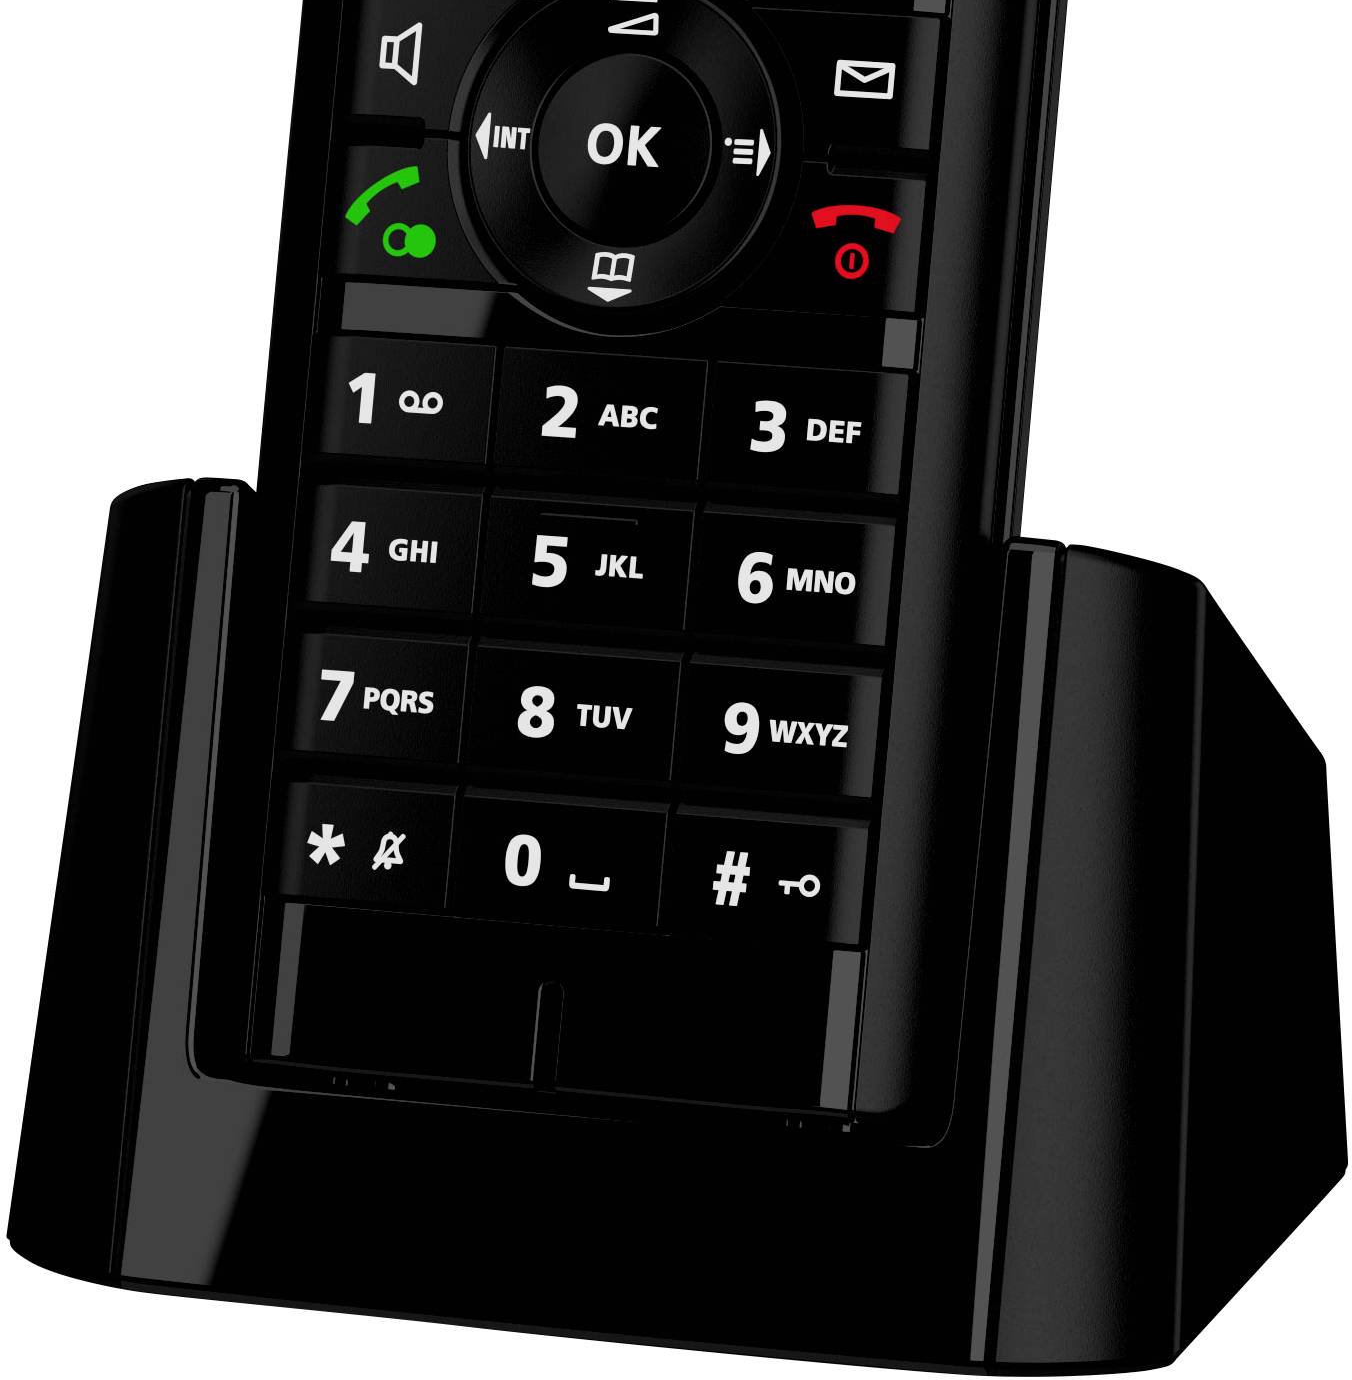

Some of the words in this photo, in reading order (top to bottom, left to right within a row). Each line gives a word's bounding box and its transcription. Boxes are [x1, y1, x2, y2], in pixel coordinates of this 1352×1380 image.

[492, 125, 531, 150] INT
[587, 122, 662, 168] OK
[348, 372, 377, 425] 1
[541, 384, 579, 439] 2
[597, 403, 659, 430] ABC
[749, 400, 787, 453] 3
[806, 418, 862, 444] DEF
[330, 520, 370, 573] 4
[388, 538, 438, 564] GHI
[531, 534, 569, 588] 5
[594, 553, 644, 580] JKL
[737, 551, 774, 604] 6
[786, 567, 856, 596] MNO
[320, 669, 355, 722] 7
[363, 686, 434, 716] PQRS
[517, 685, 555, 739] 8
[576, 703, 633, 730] TUV
[724, 701, 760, 755] 9
[769, 719, 849, 748] WXYZ
[504, 834, 542, 887] 0
[712, 850, 751, 907] #
